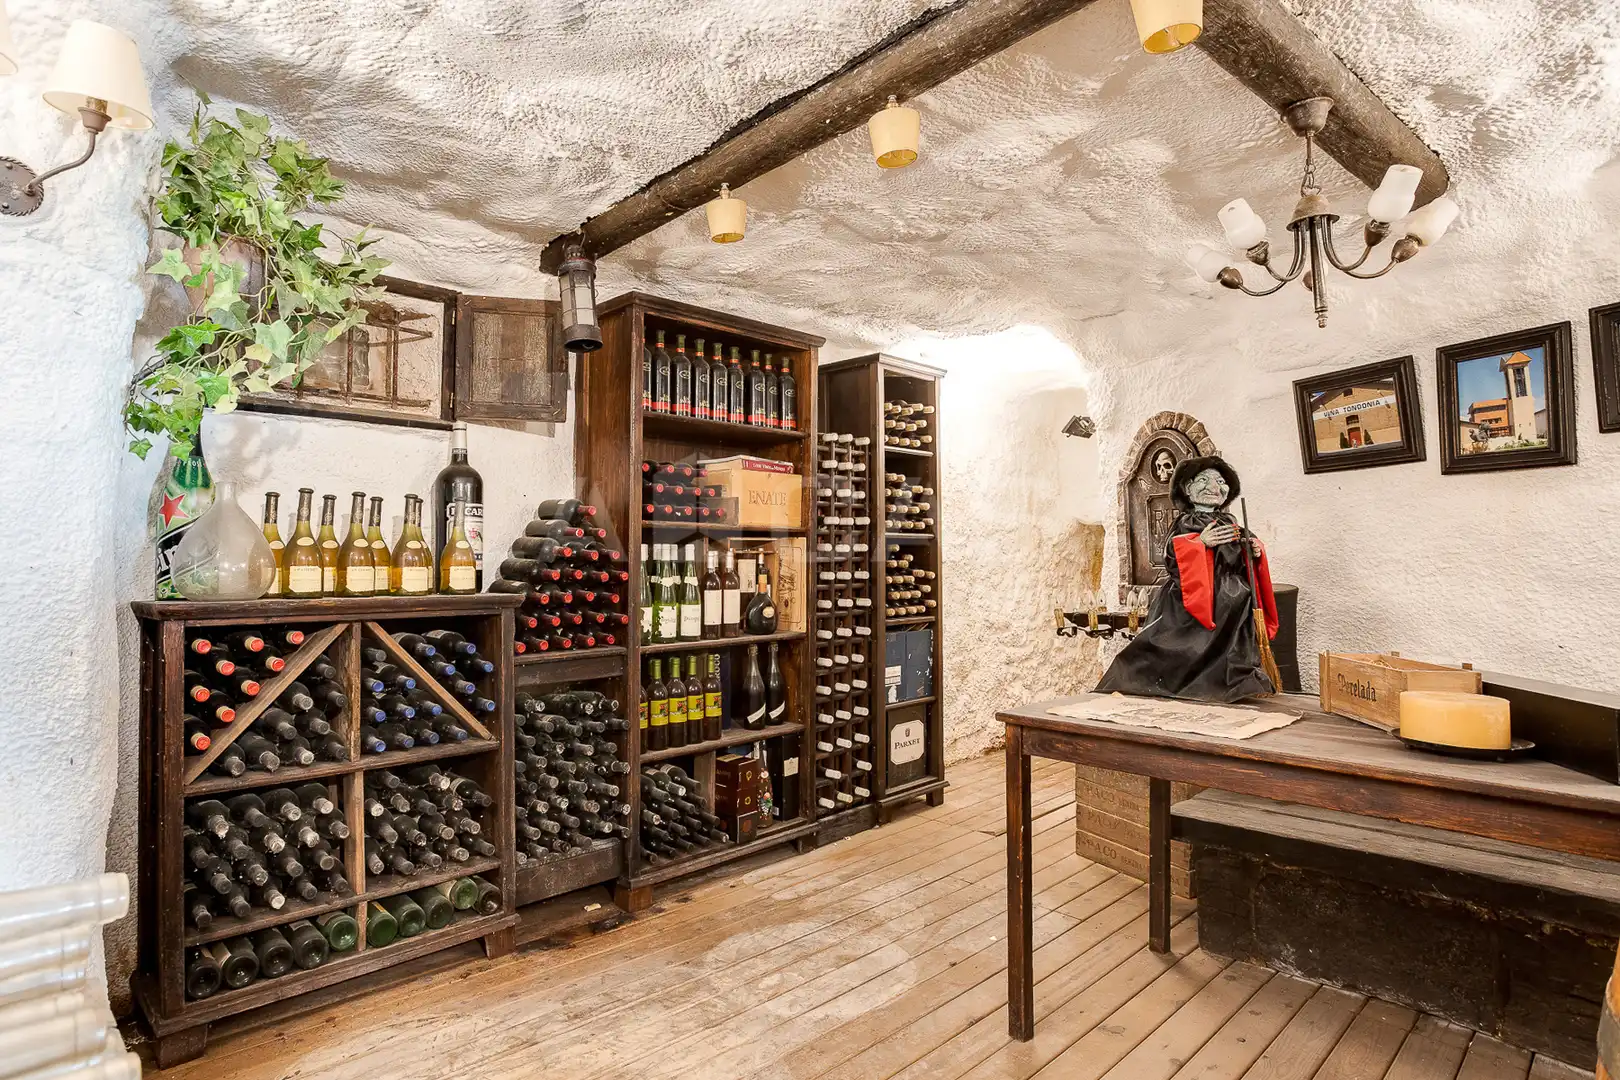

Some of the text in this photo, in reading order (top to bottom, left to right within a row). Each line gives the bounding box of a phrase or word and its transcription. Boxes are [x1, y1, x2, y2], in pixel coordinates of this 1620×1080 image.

[1343, 399, 1381, 413] TONDONIA
[748, 489, 787, 506] ENATE
[893, 737, 921, 750] PARXET
